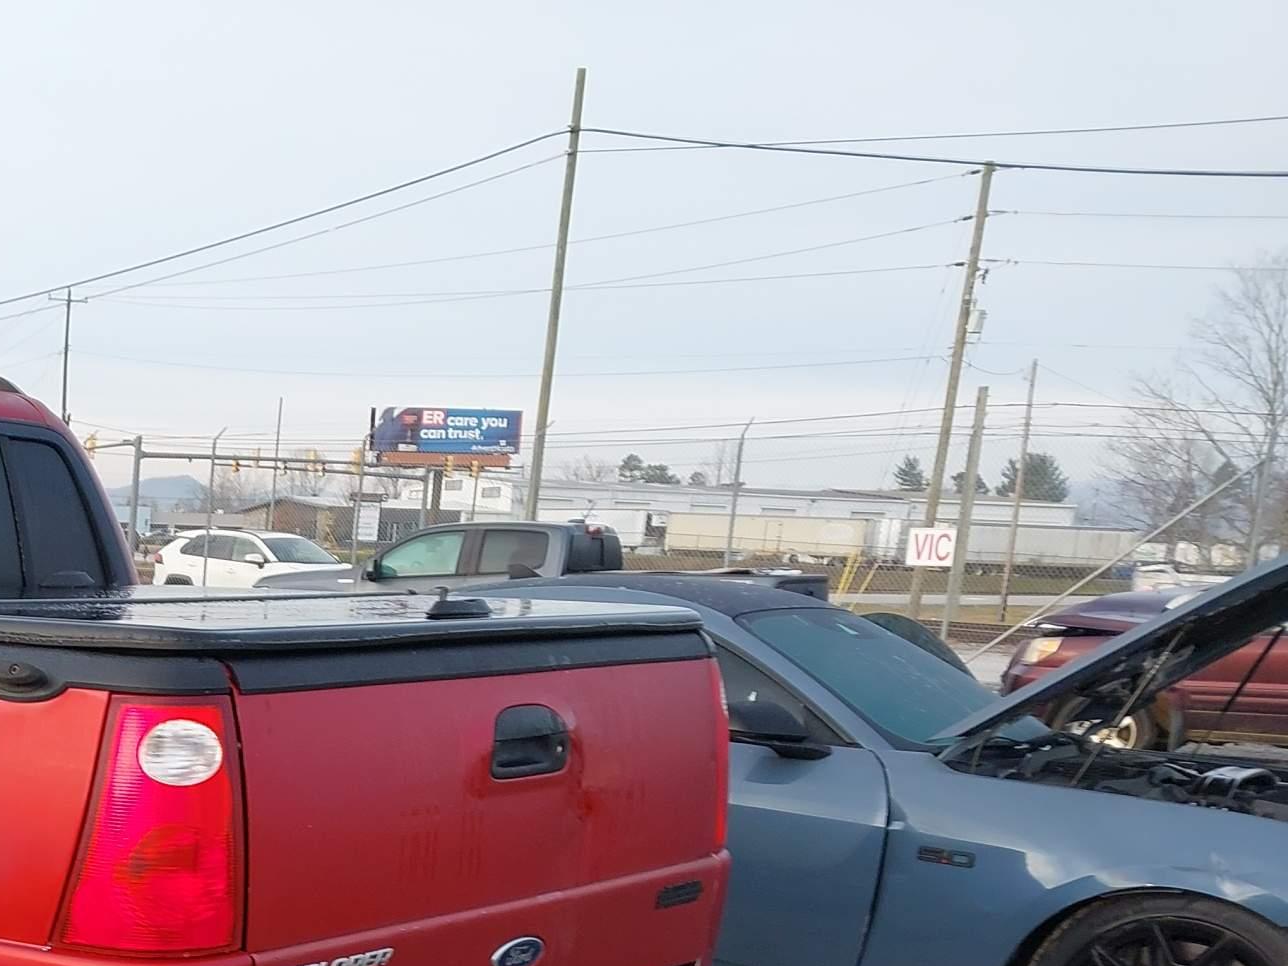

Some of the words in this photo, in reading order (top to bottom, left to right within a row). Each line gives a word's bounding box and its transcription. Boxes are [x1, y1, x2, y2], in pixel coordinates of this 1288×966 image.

[422, 410, 444, 425] ER
[446, 416, 479, 427] care
[480, 416, 508, 430] you
[419, 428, 446, 439] can
[447, 427, 484, 441] trust.
[914, 533, 952, 561] VIC
